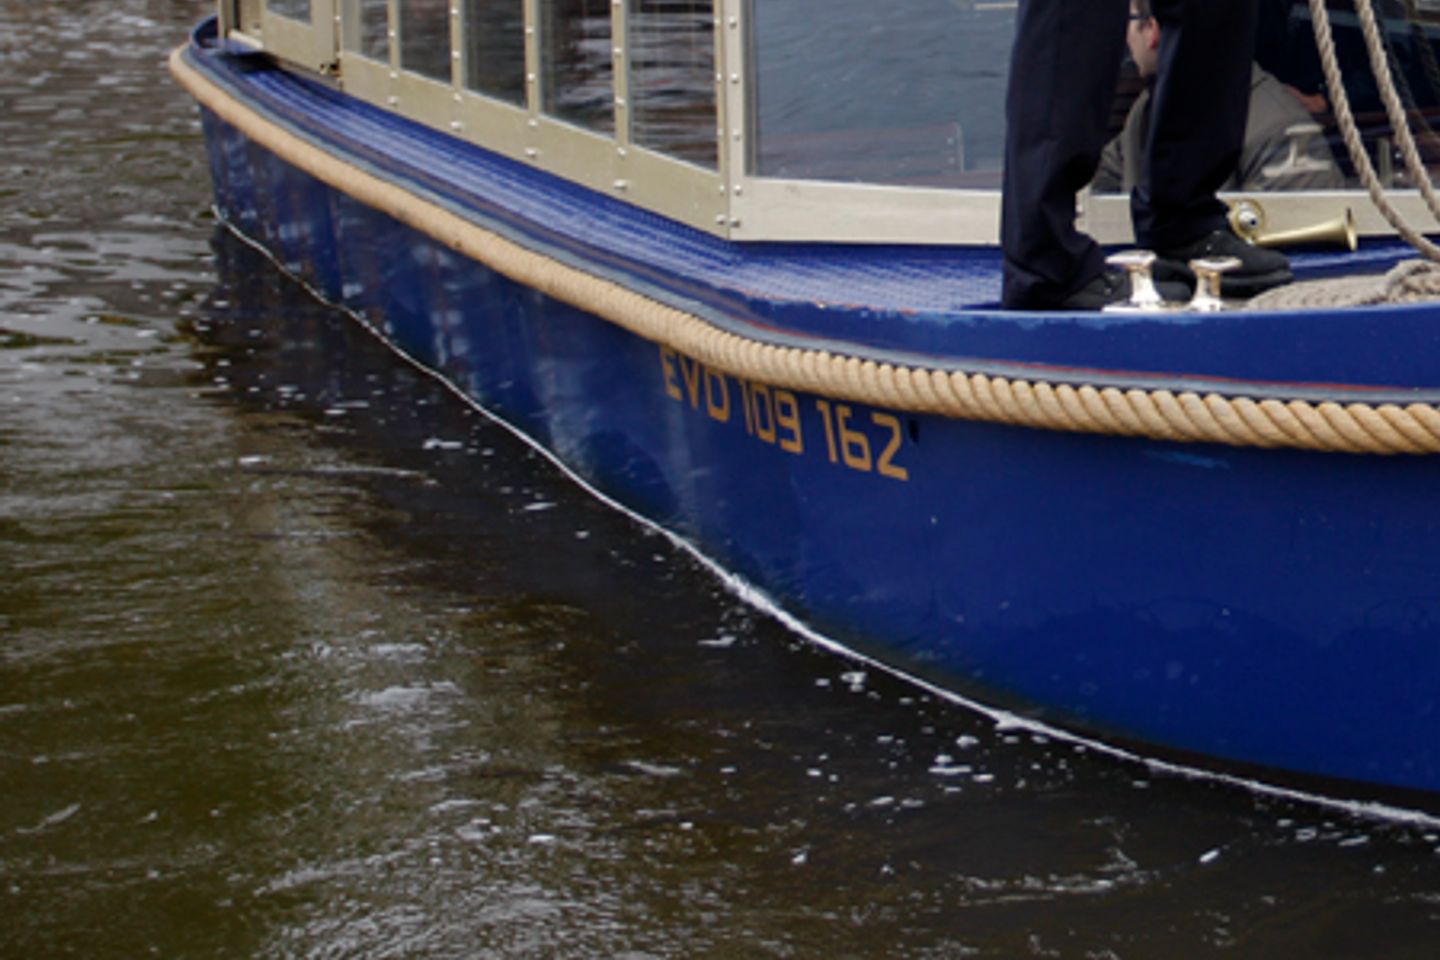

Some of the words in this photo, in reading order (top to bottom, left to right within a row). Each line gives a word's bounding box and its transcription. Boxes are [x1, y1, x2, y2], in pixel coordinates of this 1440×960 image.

[659, 342, 731, 423] EVD
[738, 378, 803, 455] 109
[816, 399, 909, 481] 162
